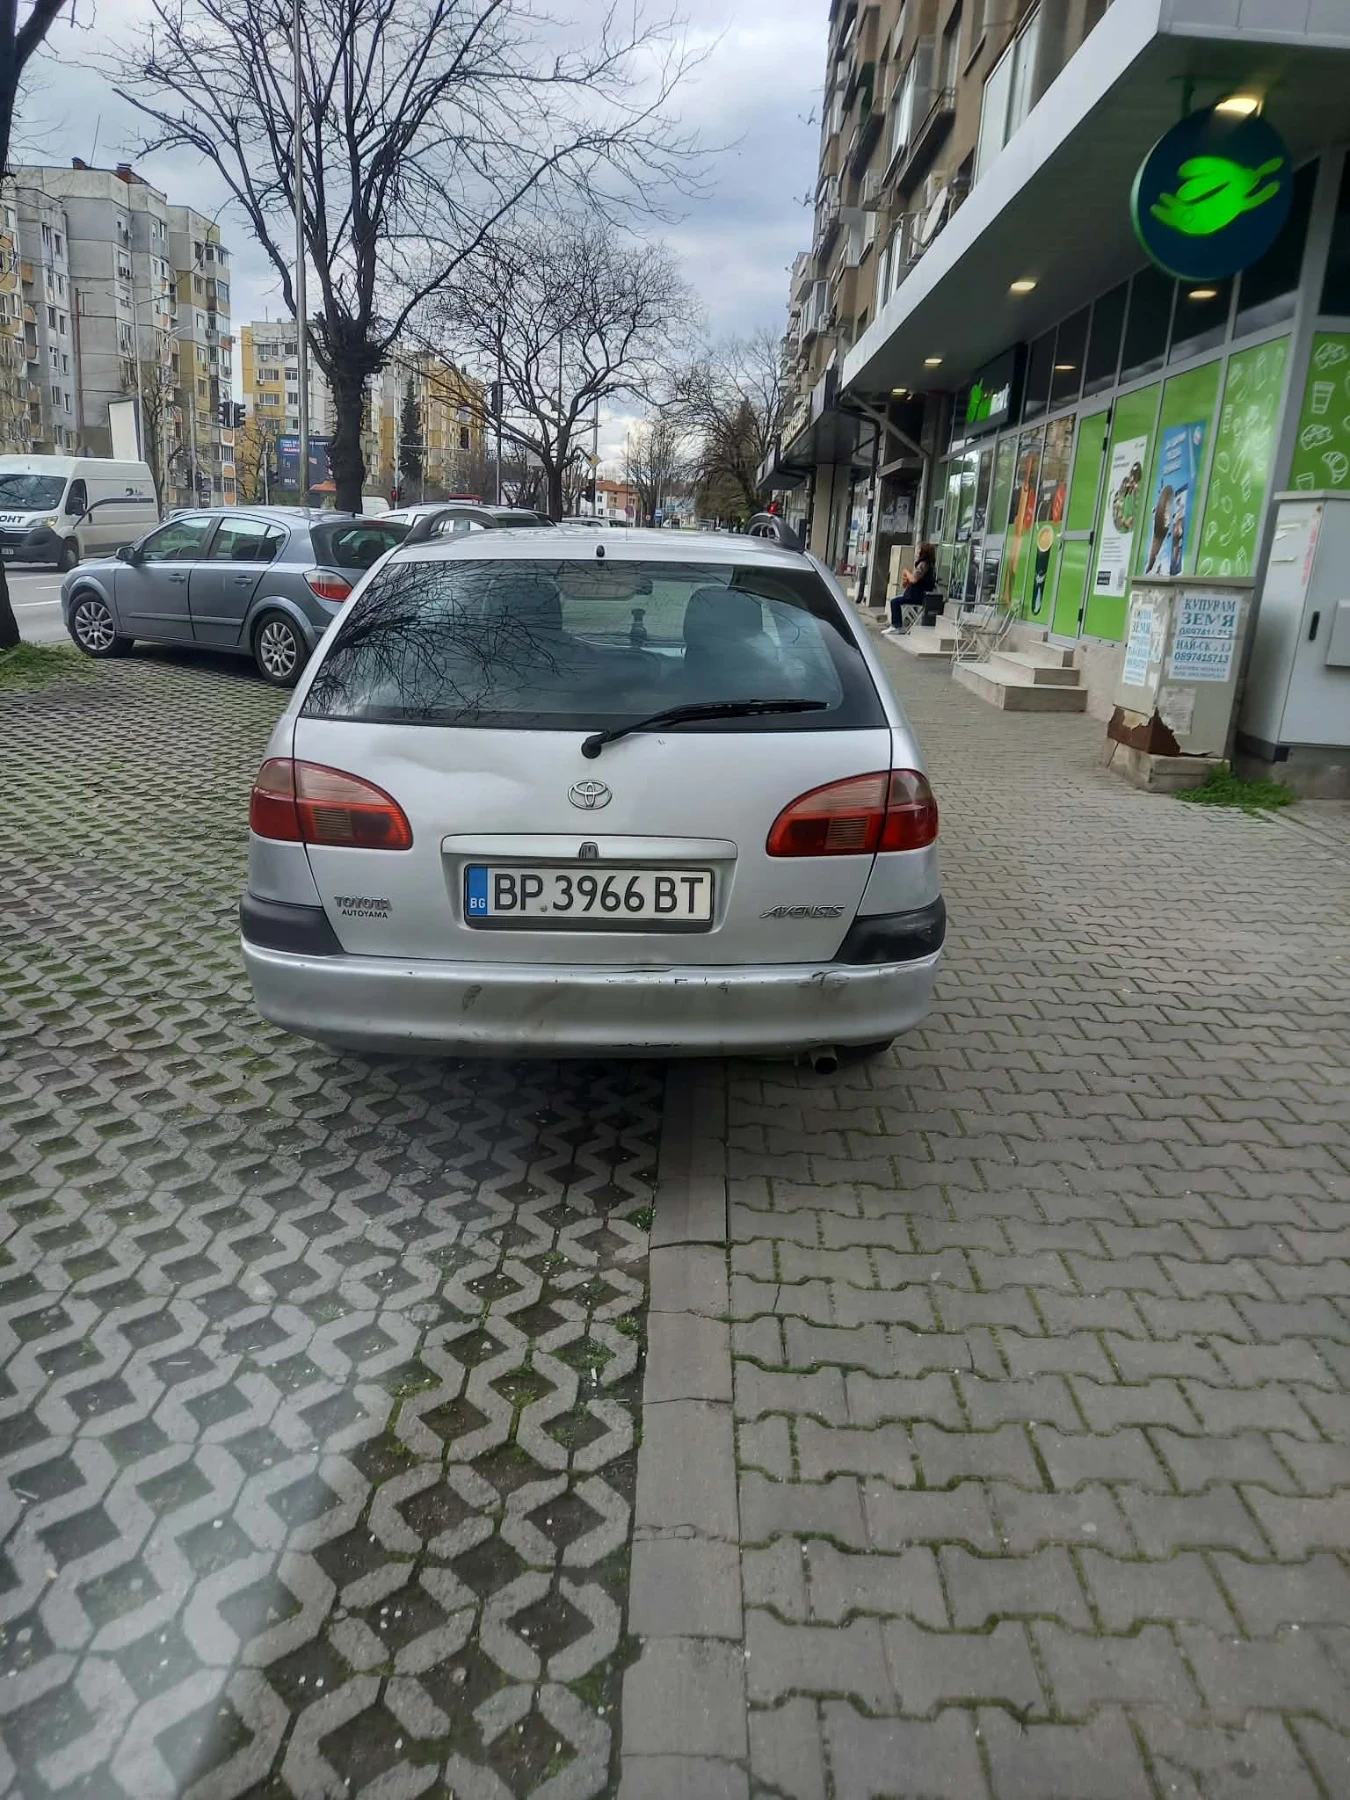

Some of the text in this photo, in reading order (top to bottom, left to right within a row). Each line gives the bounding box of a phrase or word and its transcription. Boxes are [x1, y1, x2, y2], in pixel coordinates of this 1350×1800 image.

[470, 873, 704, 914] BG BP 3966 BT
[333, 895, 393, 911] TOYOTA
[342, 909, 388, 919] AUTOYAMA
